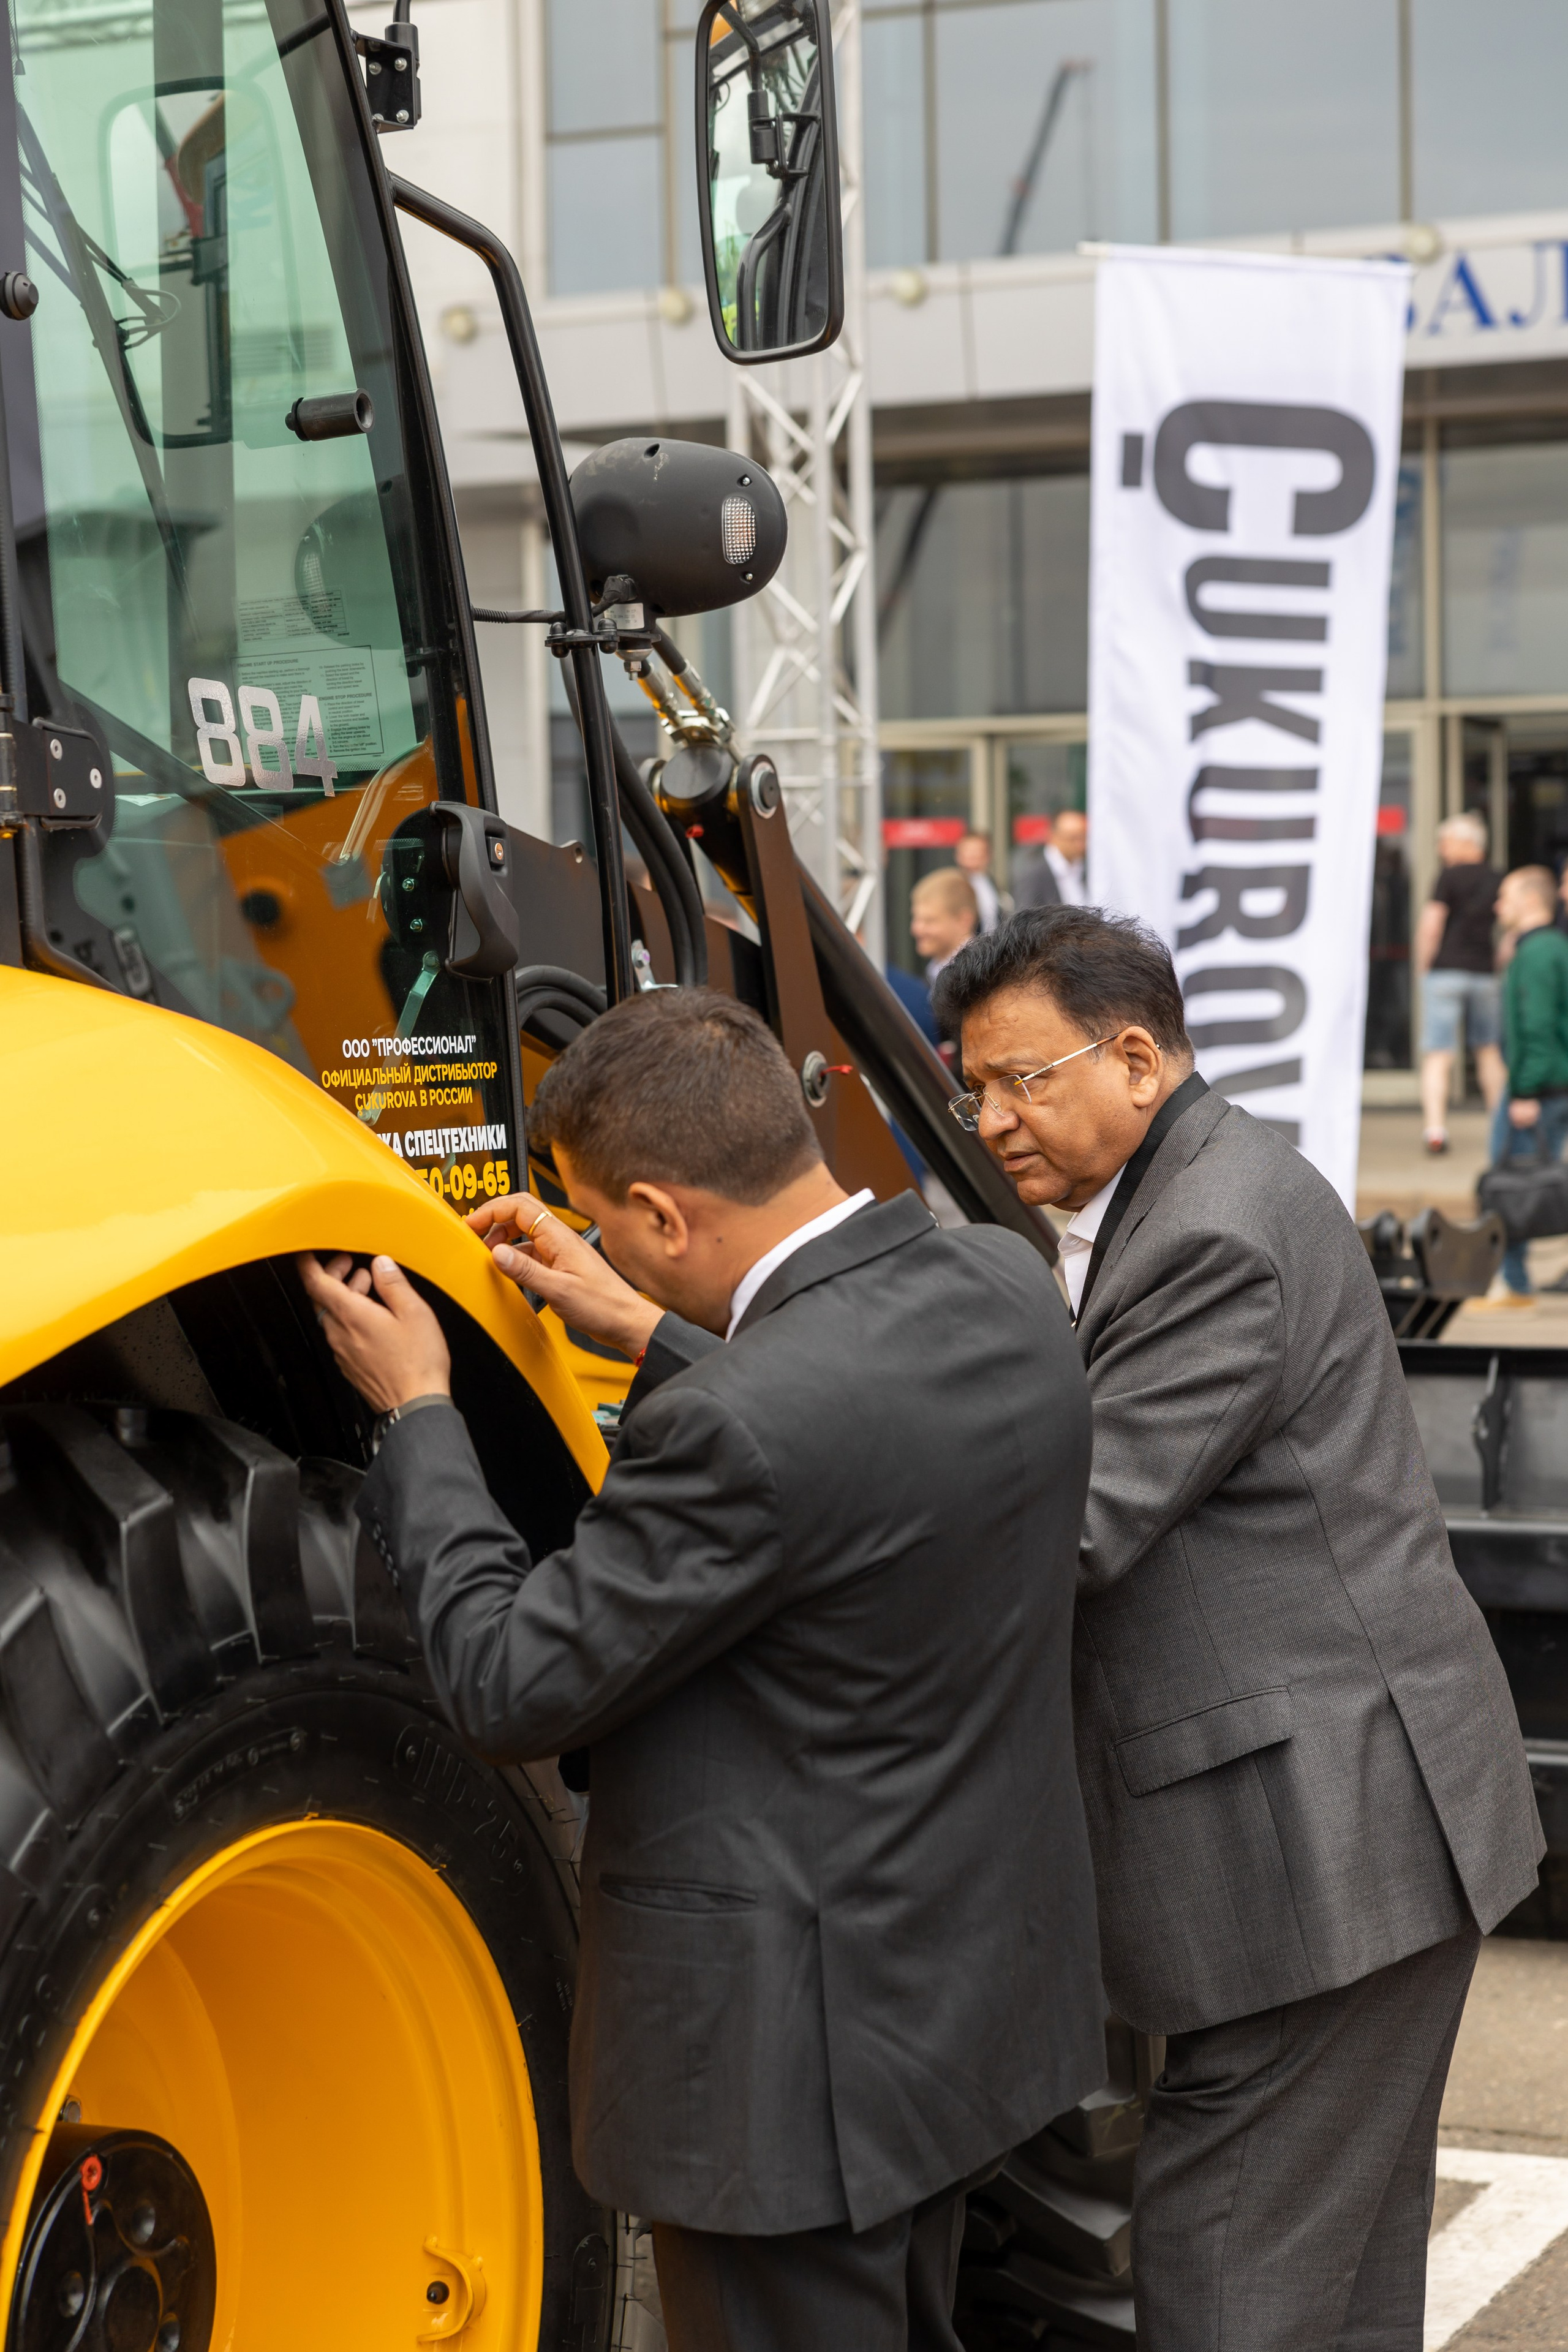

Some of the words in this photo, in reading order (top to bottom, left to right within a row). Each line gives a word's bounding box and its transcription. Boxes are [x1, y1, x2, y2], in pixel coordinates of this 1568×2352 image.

[187, 677, 338, 797] 884
[342, 1039, 370, 1058] ООО
[322, 1063, 412, 1089] ОФИЦИАЛЬНЫЙ
[413, 1062, 497, 1086] ДИСТРИБЬЮТОР
[355, 1090, 418, 1116] ÇUKUROVA
[420, 1090, 428, 1107] В
[429, 1087, 473, 1106] РОССИИ
[404, 1124, 507, 1158] СПЕЦТЕХНИКИ
